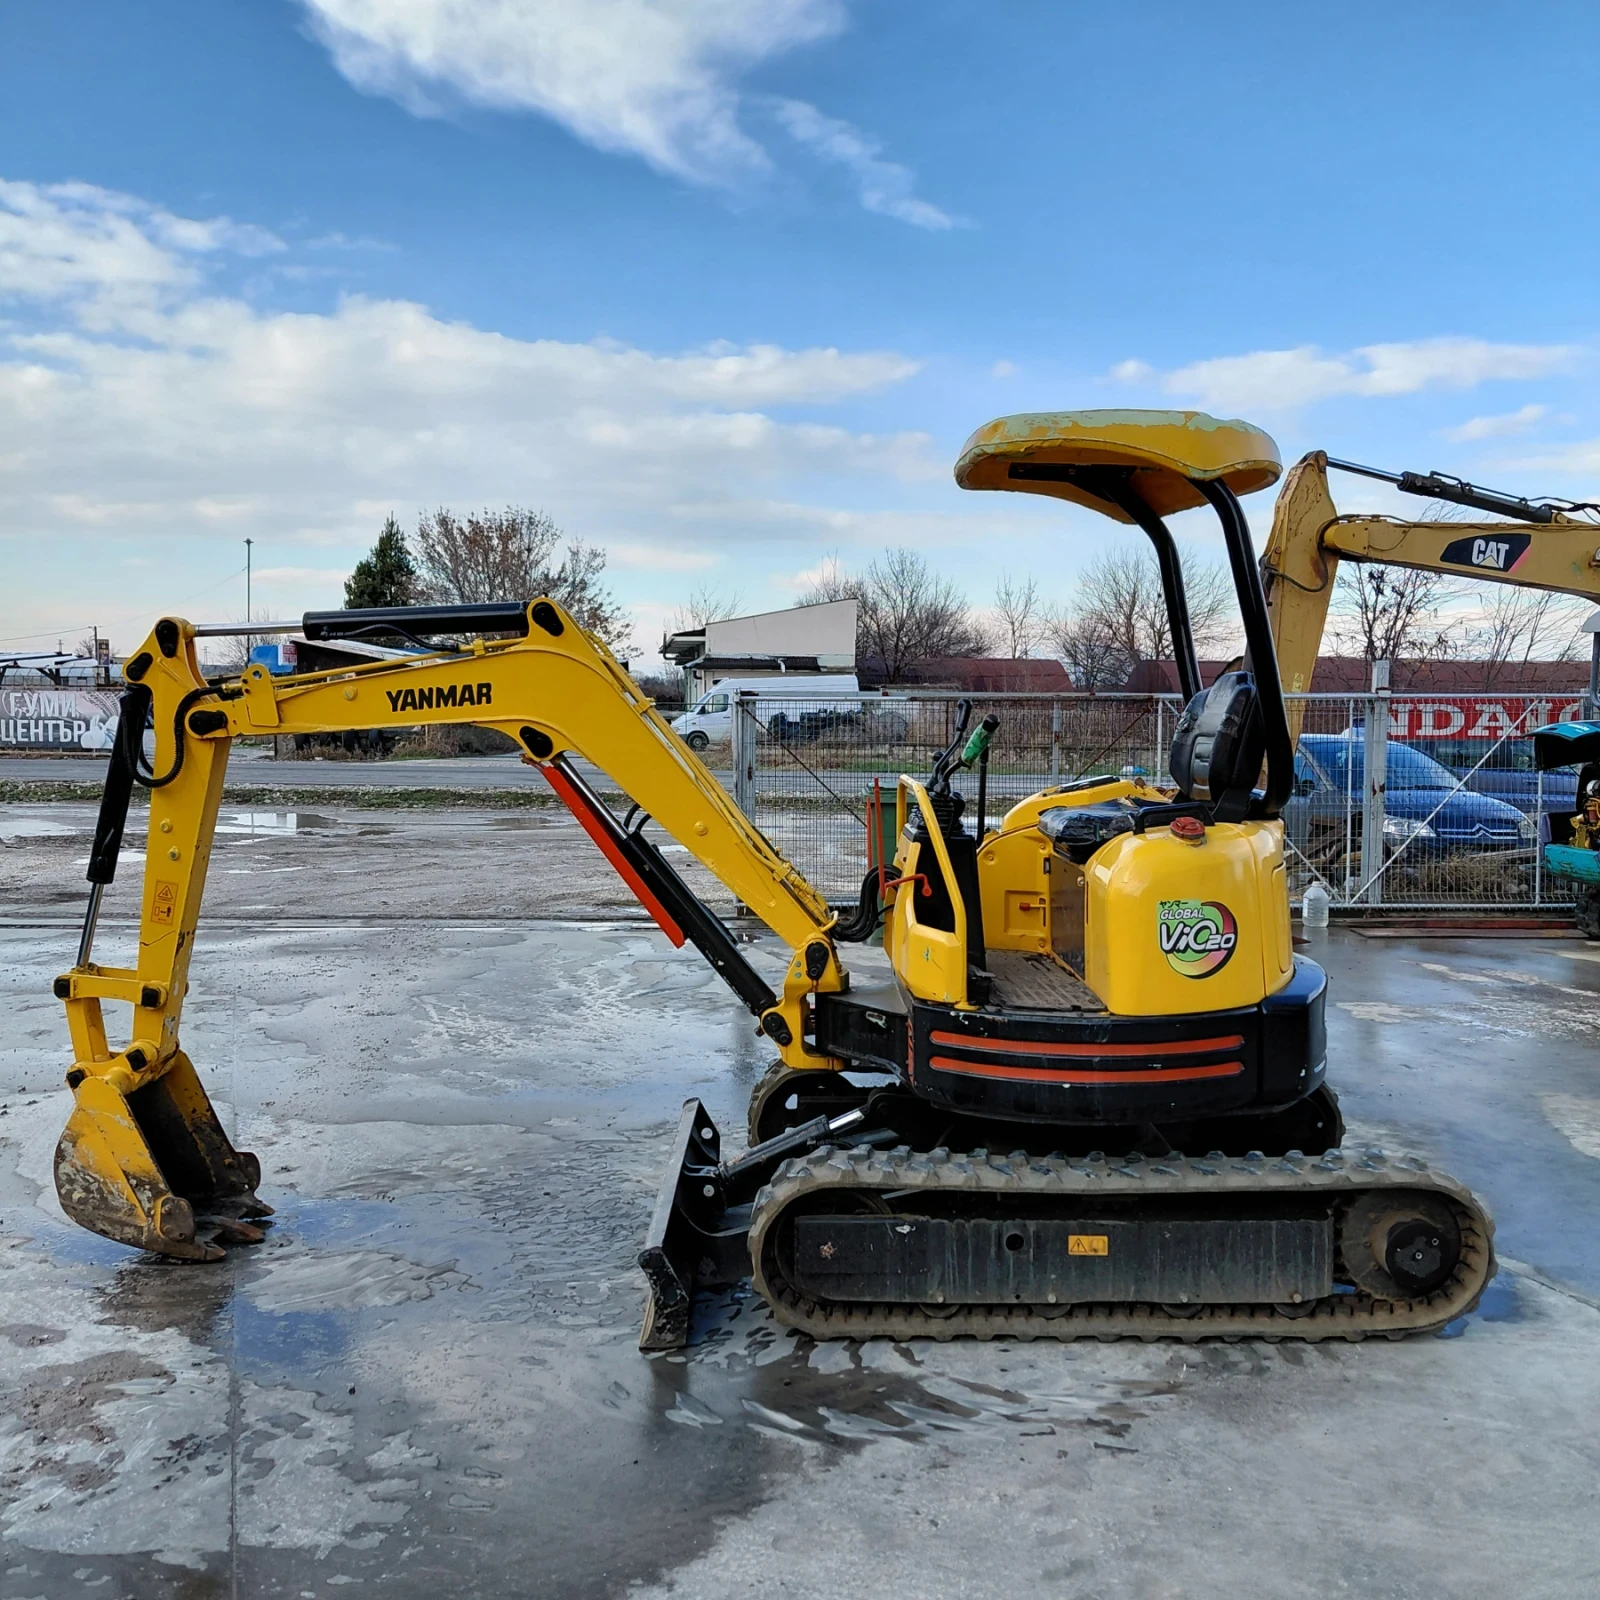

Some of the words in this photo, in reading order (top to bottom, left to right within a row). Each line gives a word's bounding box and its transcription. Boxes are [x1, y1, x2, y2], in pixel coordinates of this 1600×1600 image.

[1471, 538, 1510, 569] CAT
[9, 692, 77, 718] ГУМИ
[385, 682, 493, 713] YANMAR
[0, 719, 87, 745] ЦЕНТЪР
[1159, 900, 1189, 909] ヤンマー
[1160, 908, 1206, 920] GLOBAL
